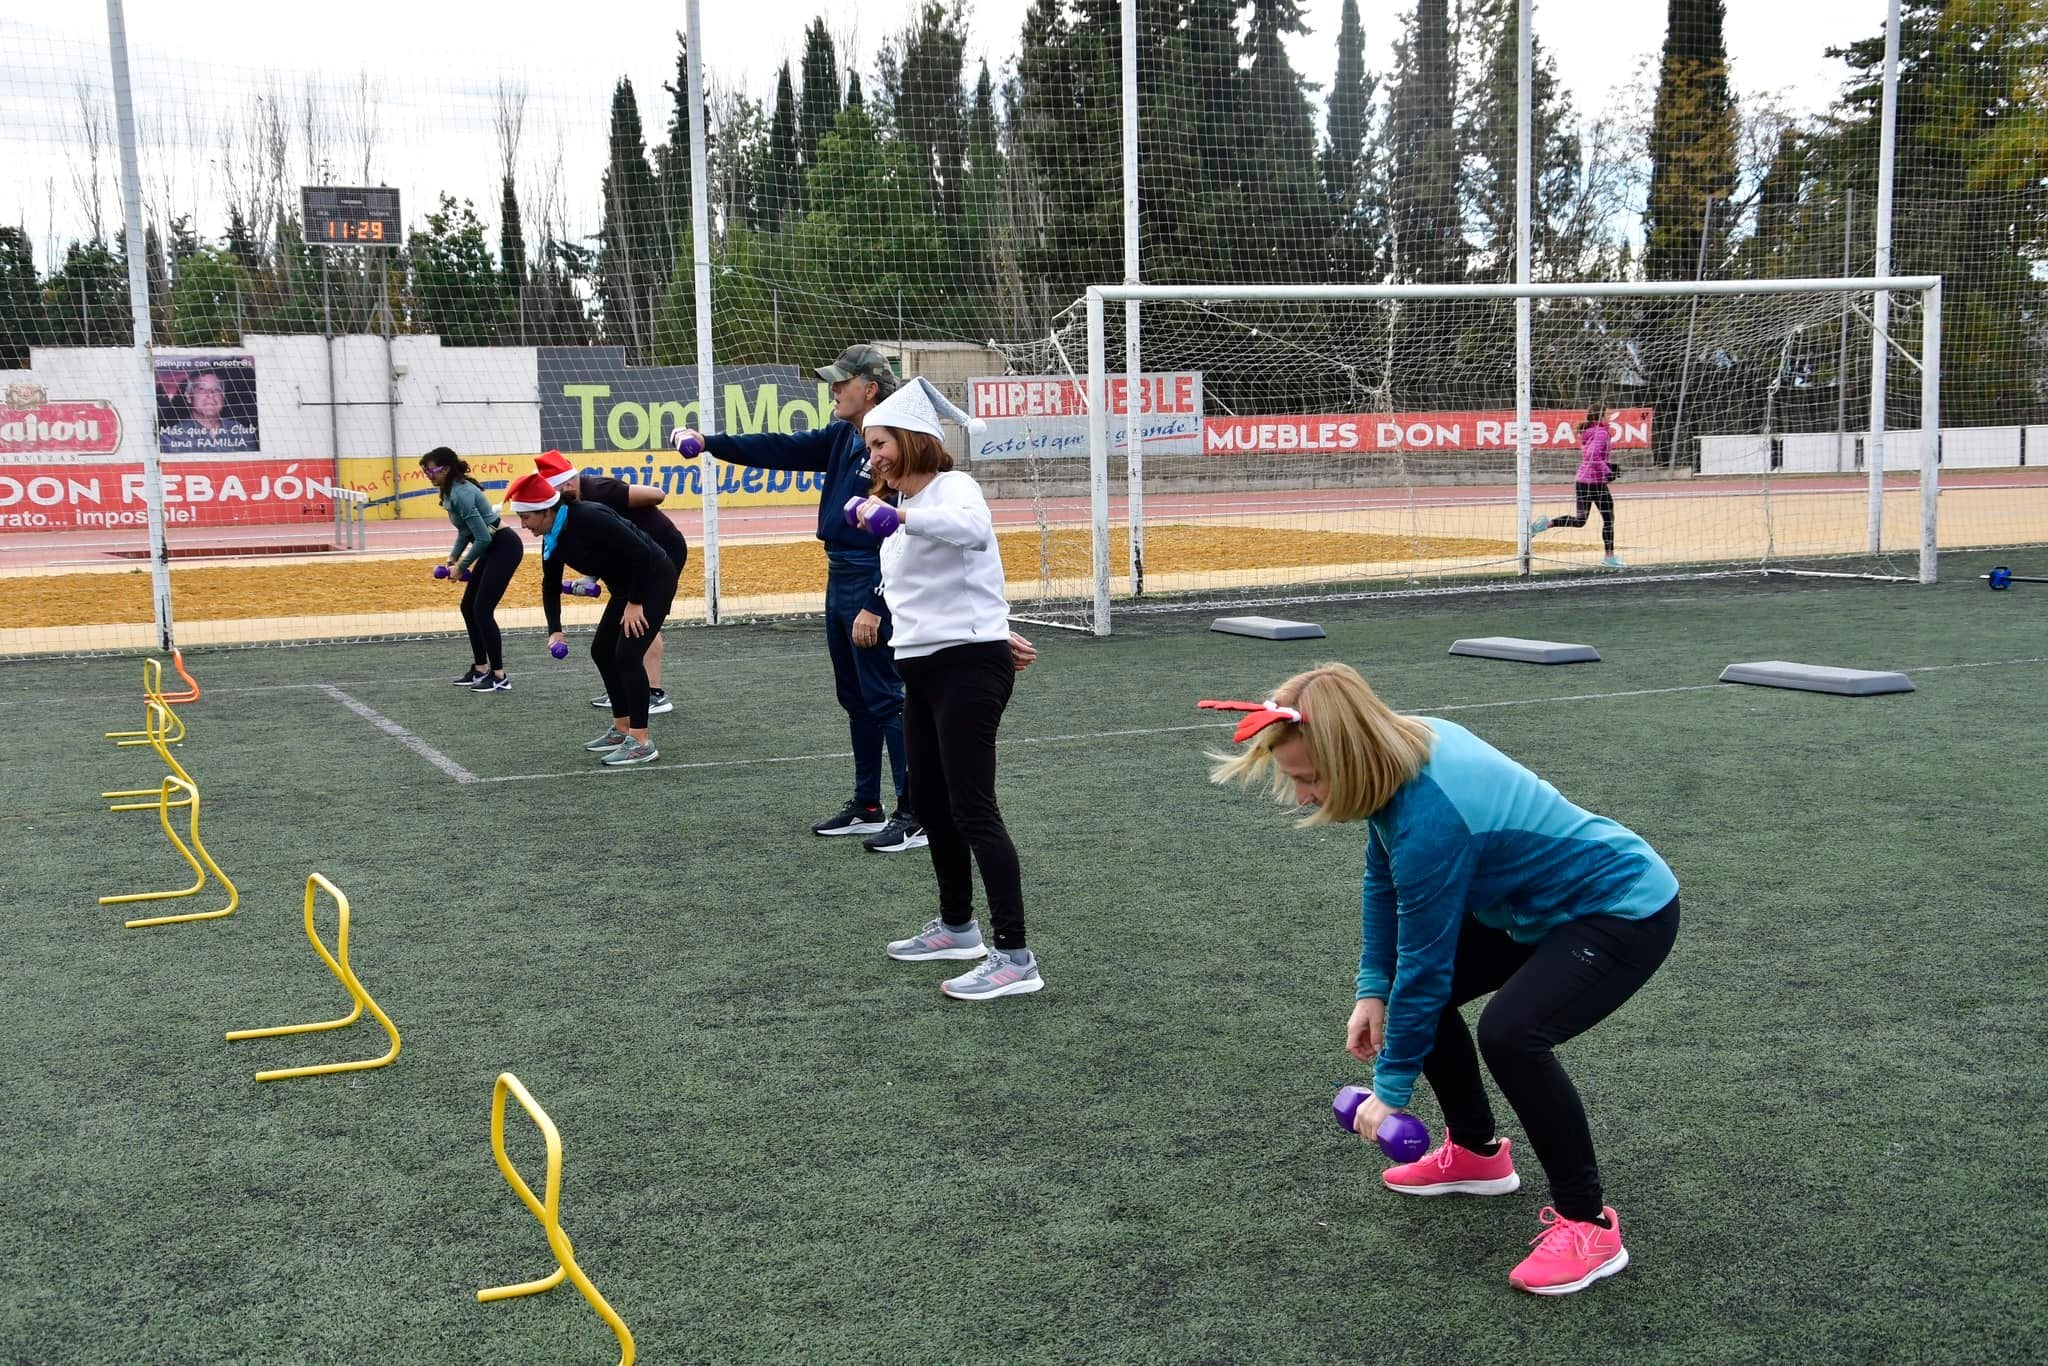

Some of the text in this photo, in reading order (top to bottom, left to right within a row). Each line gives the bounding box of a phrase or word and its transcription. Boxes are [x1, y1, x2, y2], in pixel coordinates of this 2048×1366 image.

[329, 220, 384, 240] 11:29
[155, 359, 191, 369] Siempre
[160, 424, 184, 436] Más
[187, 426, 207, 437] que
[230, 423, 256, 435] Club
[1208, 411, 1648, 450] MUEBLES DON REBAÓN
[171, 438, 247, 448] una FAMILIA
[0, 455, 76, 463] ERVEZAS
[0, 463, 333, 506] DON REBAJÓN
[0, 506, 196, 529] rato... imposle!
